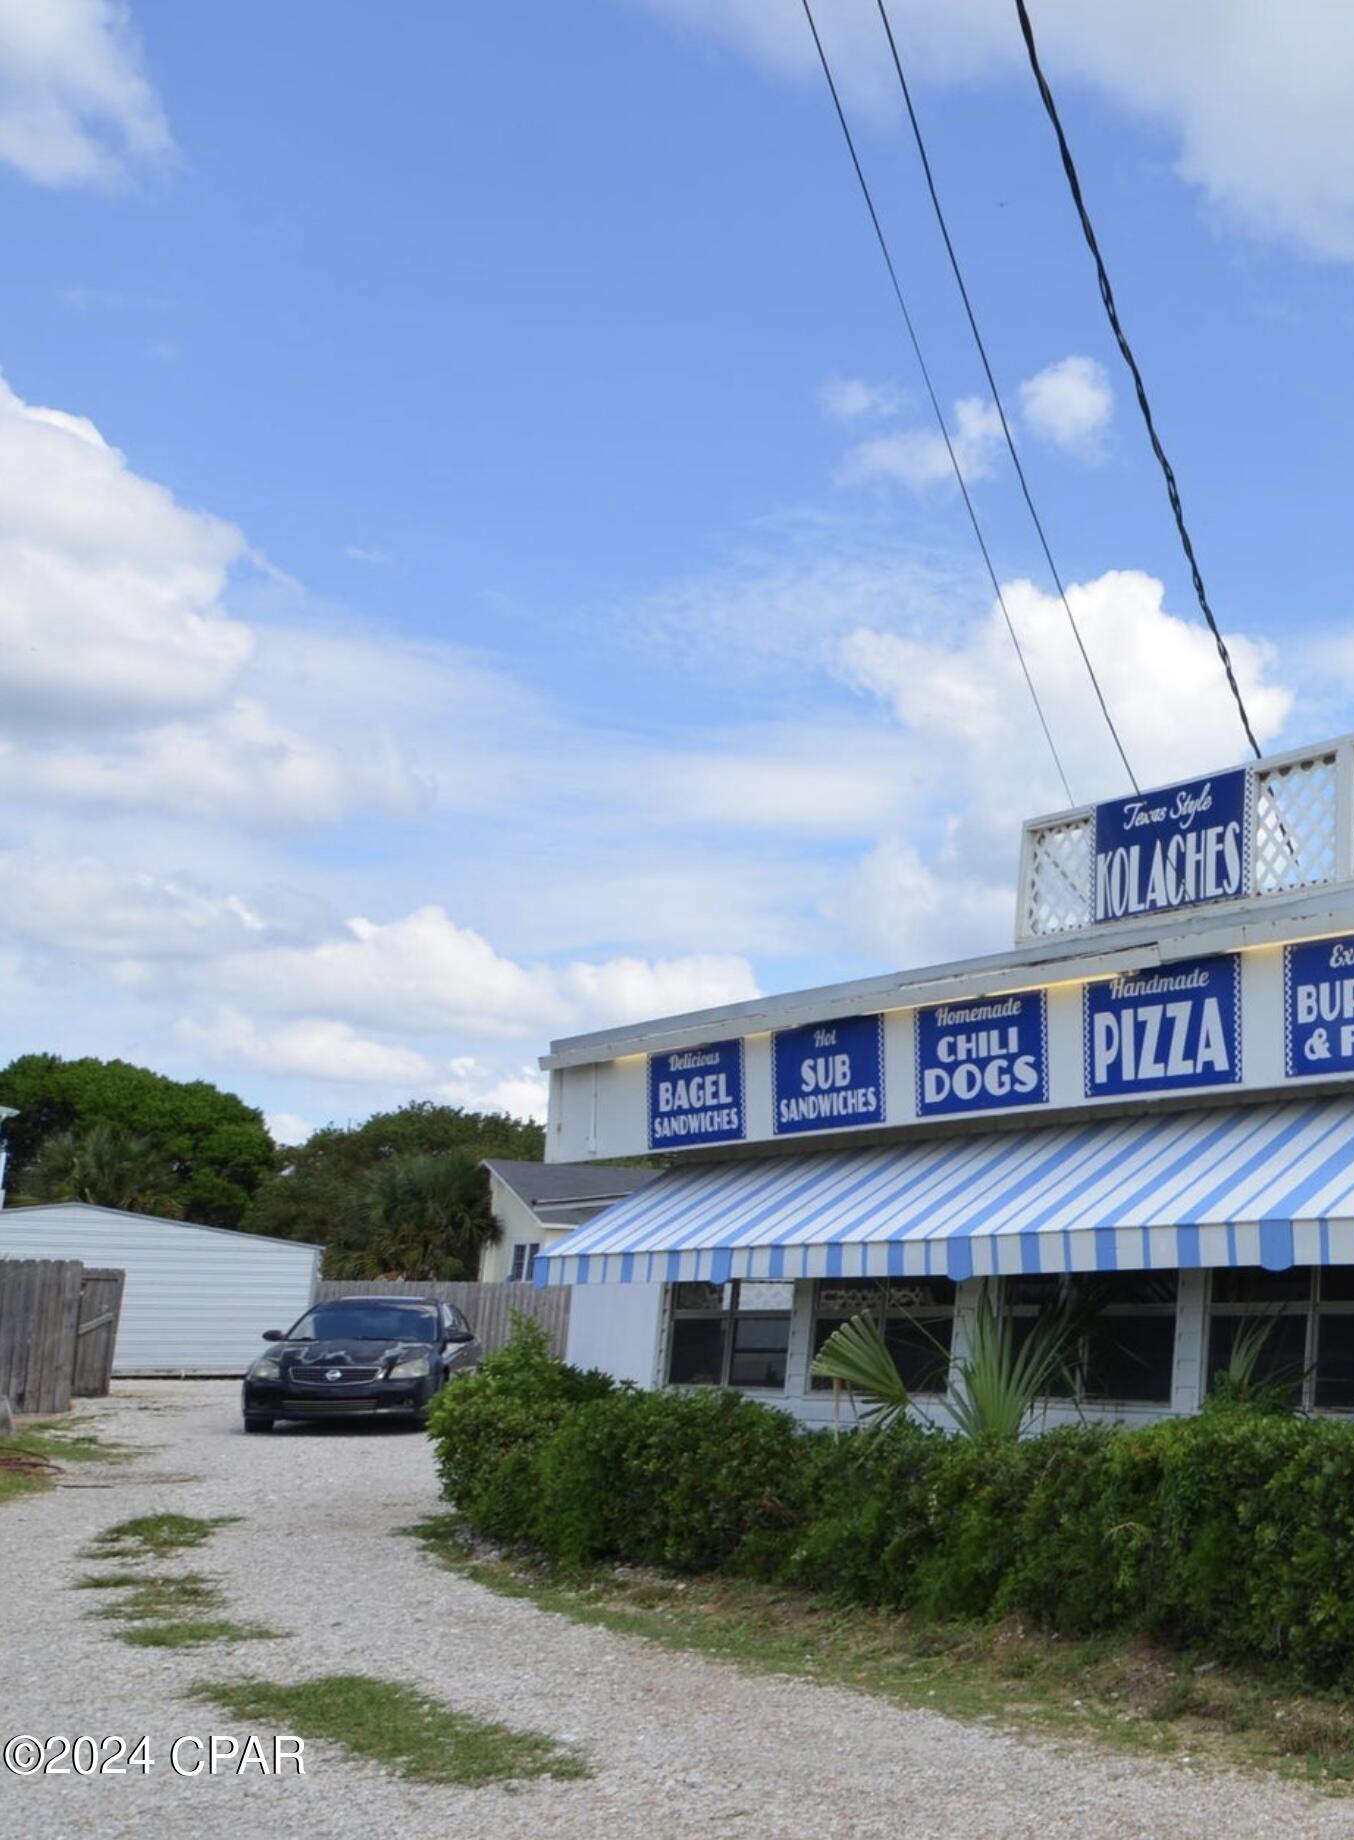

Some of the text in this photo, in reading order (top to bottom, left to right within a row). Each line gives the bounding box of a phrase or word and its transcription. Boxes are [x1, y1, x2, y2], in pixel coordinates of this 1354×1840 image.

[1123, 782, 1213, 831] Texas Style
[1096, 820, 1241, 921] KOLACHES
[1109, 968, 1210, 1001] Handmade
[936, 998, 1023, 1028] Homemade
[813, 1030, 838, 1049] Hot
[937, 1026, 1020, 1064] CHILI
[1094, 997, 1229, 1084] PIZZA
[1304, 1028, 1332, 1062] &
[669, 1051, 721, 1073] Delicious
[801, 1053, 851, 1093] SUB
[924, 1054, 1038, 1104] DOGS
[658, 1072, 733, 1113] BAGEL
[780, 1086, 877, 1124] SANDWICHES
[654, 1107, 739, 1139] SANDWICHES
